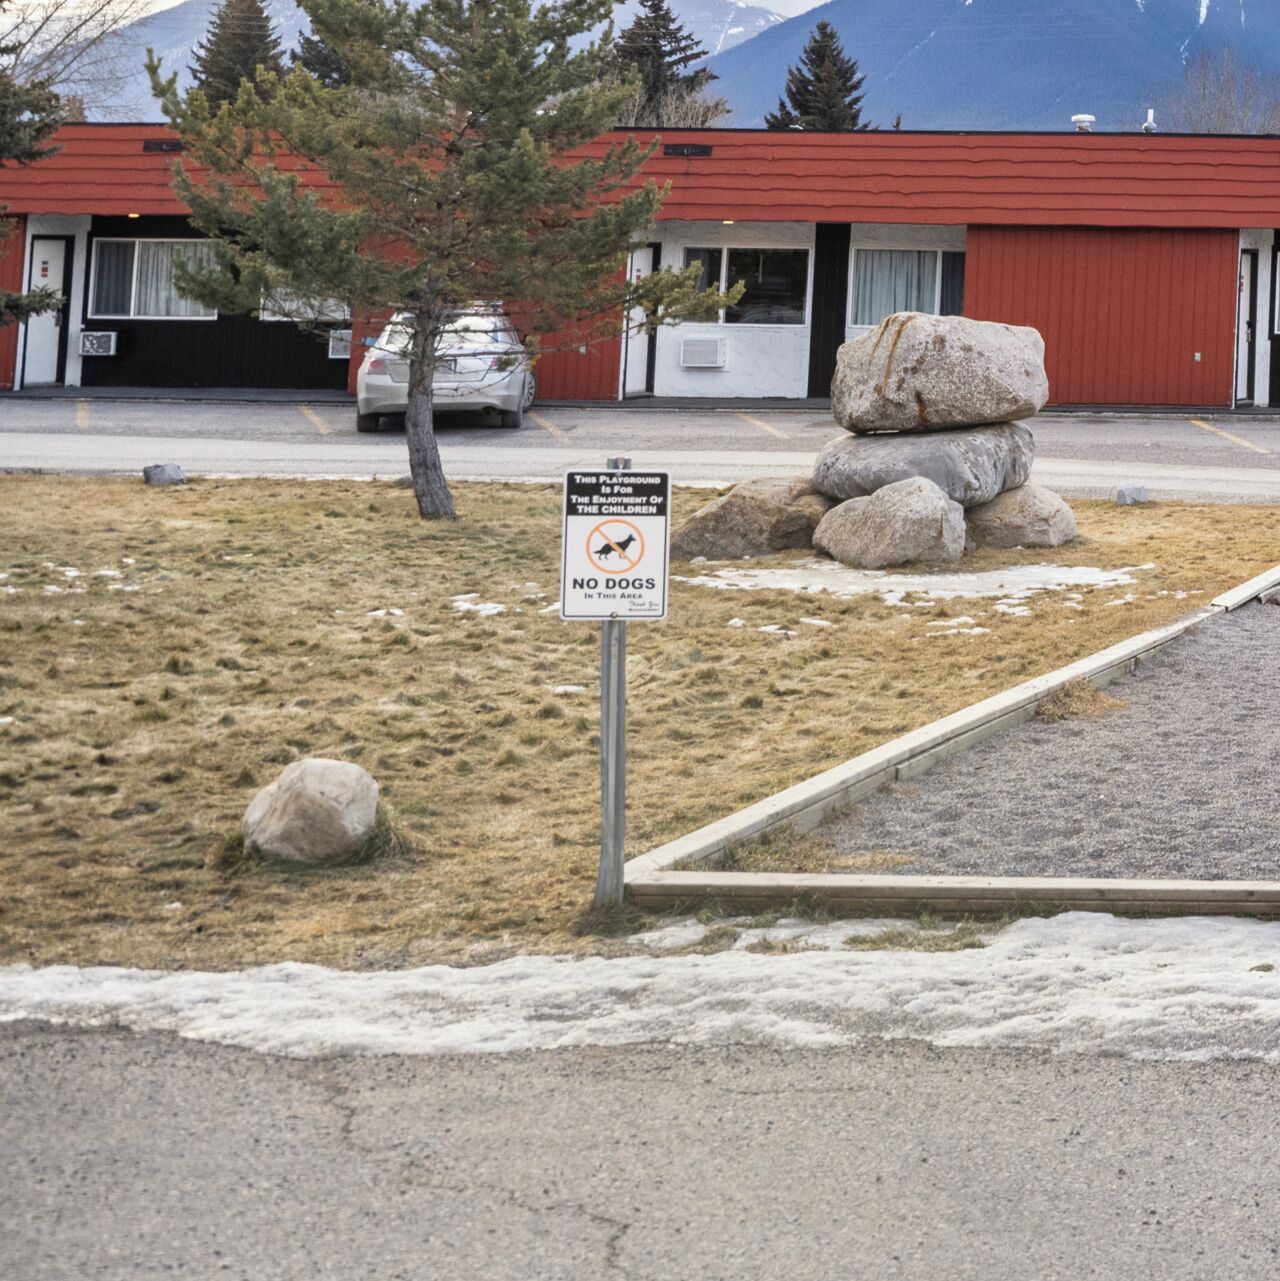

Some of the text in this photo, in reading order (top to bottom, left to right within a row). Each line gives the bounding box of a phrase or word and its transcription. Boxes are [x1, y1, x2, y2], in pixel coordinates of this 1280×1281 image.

[570, 495, 590, 504] THE
[576, 505, 657, 514] THE CHILDREN
[572, 578, 656, 590] NO DOGS
